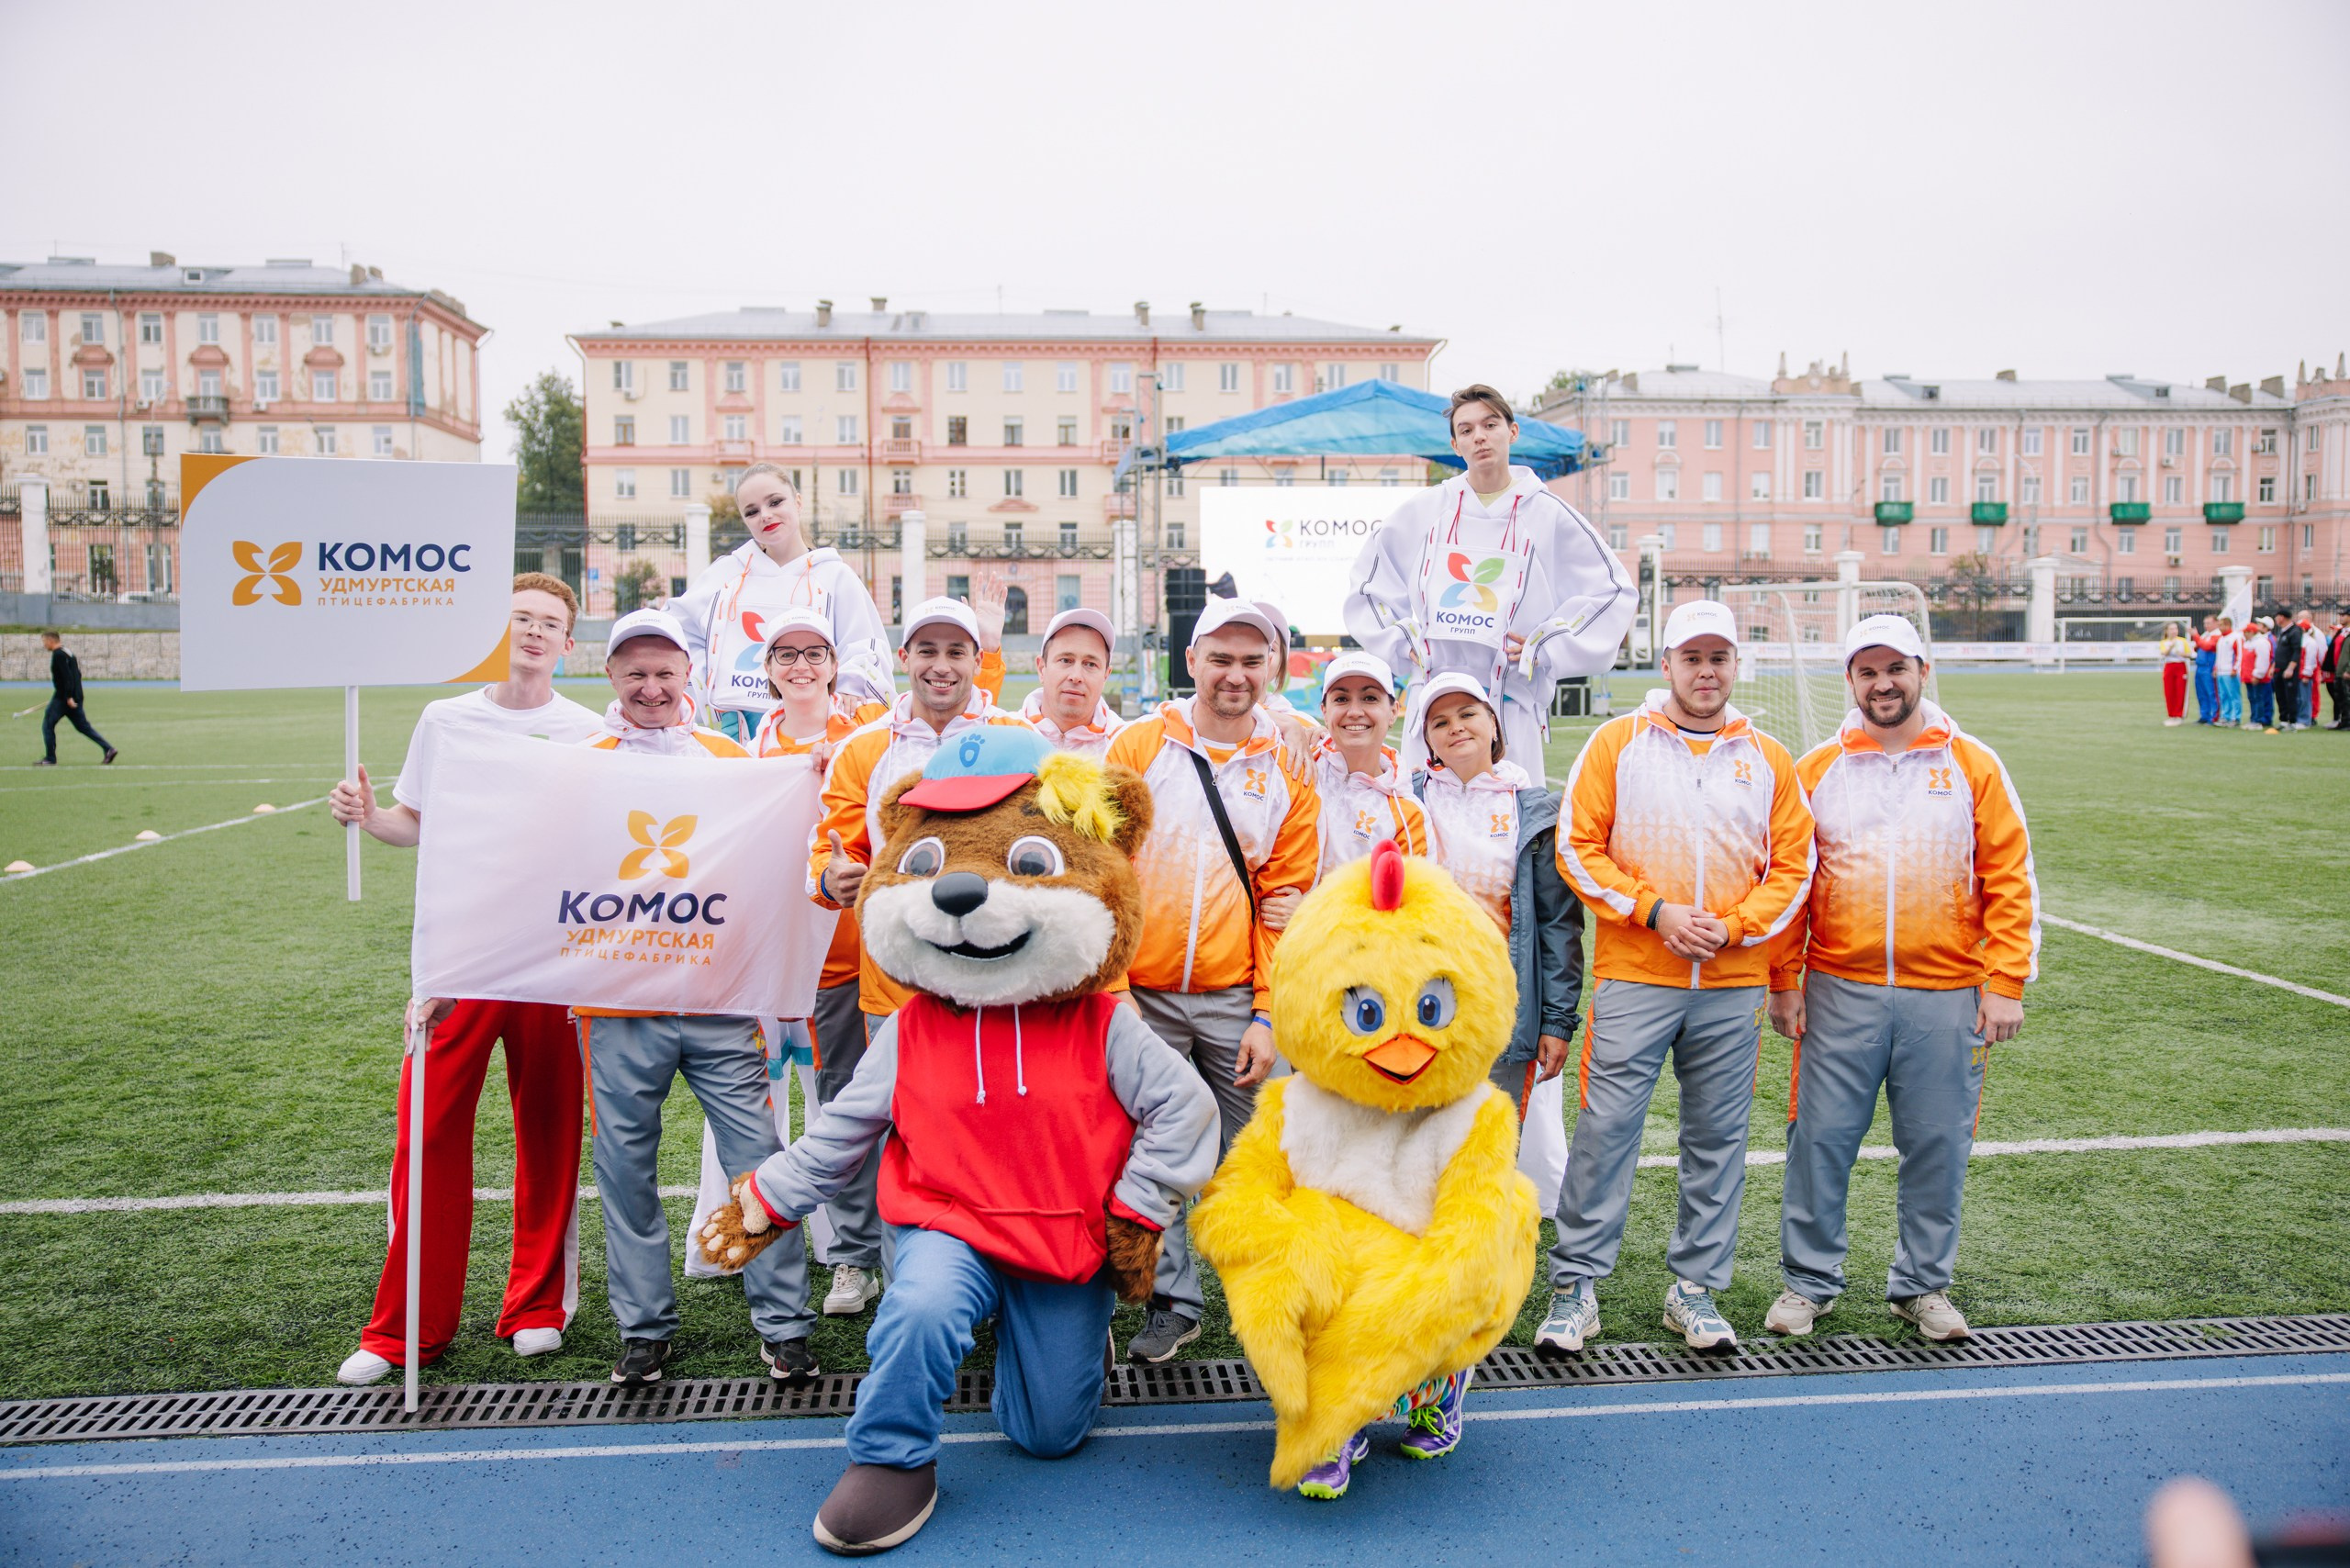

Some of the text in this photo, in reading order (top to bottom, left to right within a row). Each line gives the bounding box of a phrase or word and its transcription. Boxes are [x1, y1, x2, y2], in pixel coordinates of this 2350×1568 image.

[319, 543, 471, 572] КОМОС
[319, 577, 454, 594] УДМУРТСКАЯ
[318, 597, 454, 607] ПТИЦЕФАБРИКА
[1437, 611, 1494, 628] КОМОС
[732, 675, 769, 689] КОМ
[1734, 778, 1752, 787] КОМОС
[1243, 791, 1264, 801] КОМОС
[1353, 830, 1371, 840] КОМОС
[558, 890, 728, 925] КОМОС
[566, 928, 715, 949] УДМУРТСКАЯ
[560, 947, 711, 965] ПТИЦЕФАБРИКА
